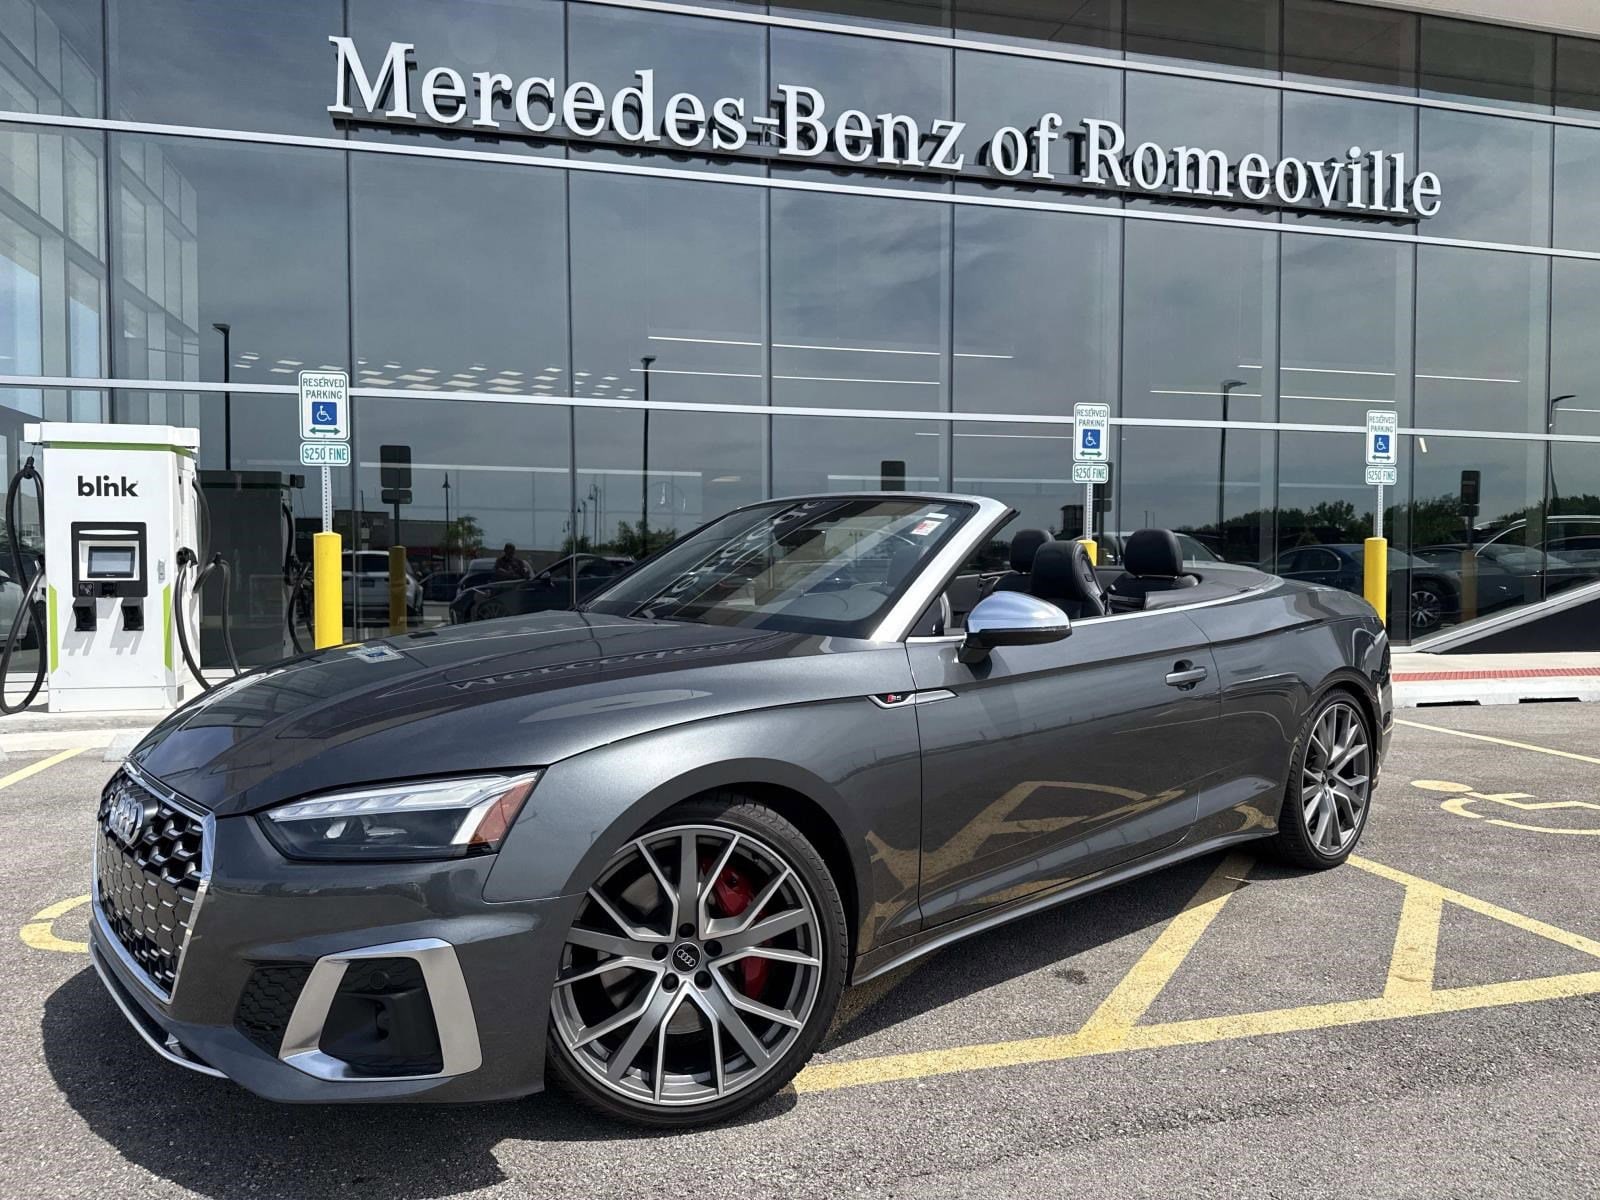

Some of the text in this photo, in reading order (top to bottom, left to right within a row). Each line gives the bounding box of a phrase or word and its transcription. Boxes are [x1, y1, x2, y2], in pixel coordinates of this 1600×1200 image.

[327, 35, 1442, 217] Mercedes-Benz of Romeoville
[303, 377, 345, 388] RESERVED
[306, 389, 343, 400] PARKING
[1076, 409, 1107, 418] RESERVED
[1078, 419, 1105, 427] PARKING
[1370, 425, 1394, 433] PARKING
[304, 447, 347, 461] $250 FINE
[1075, 467, 1106, 479] $250 FINE
[77, 474, 139, 497] blink
